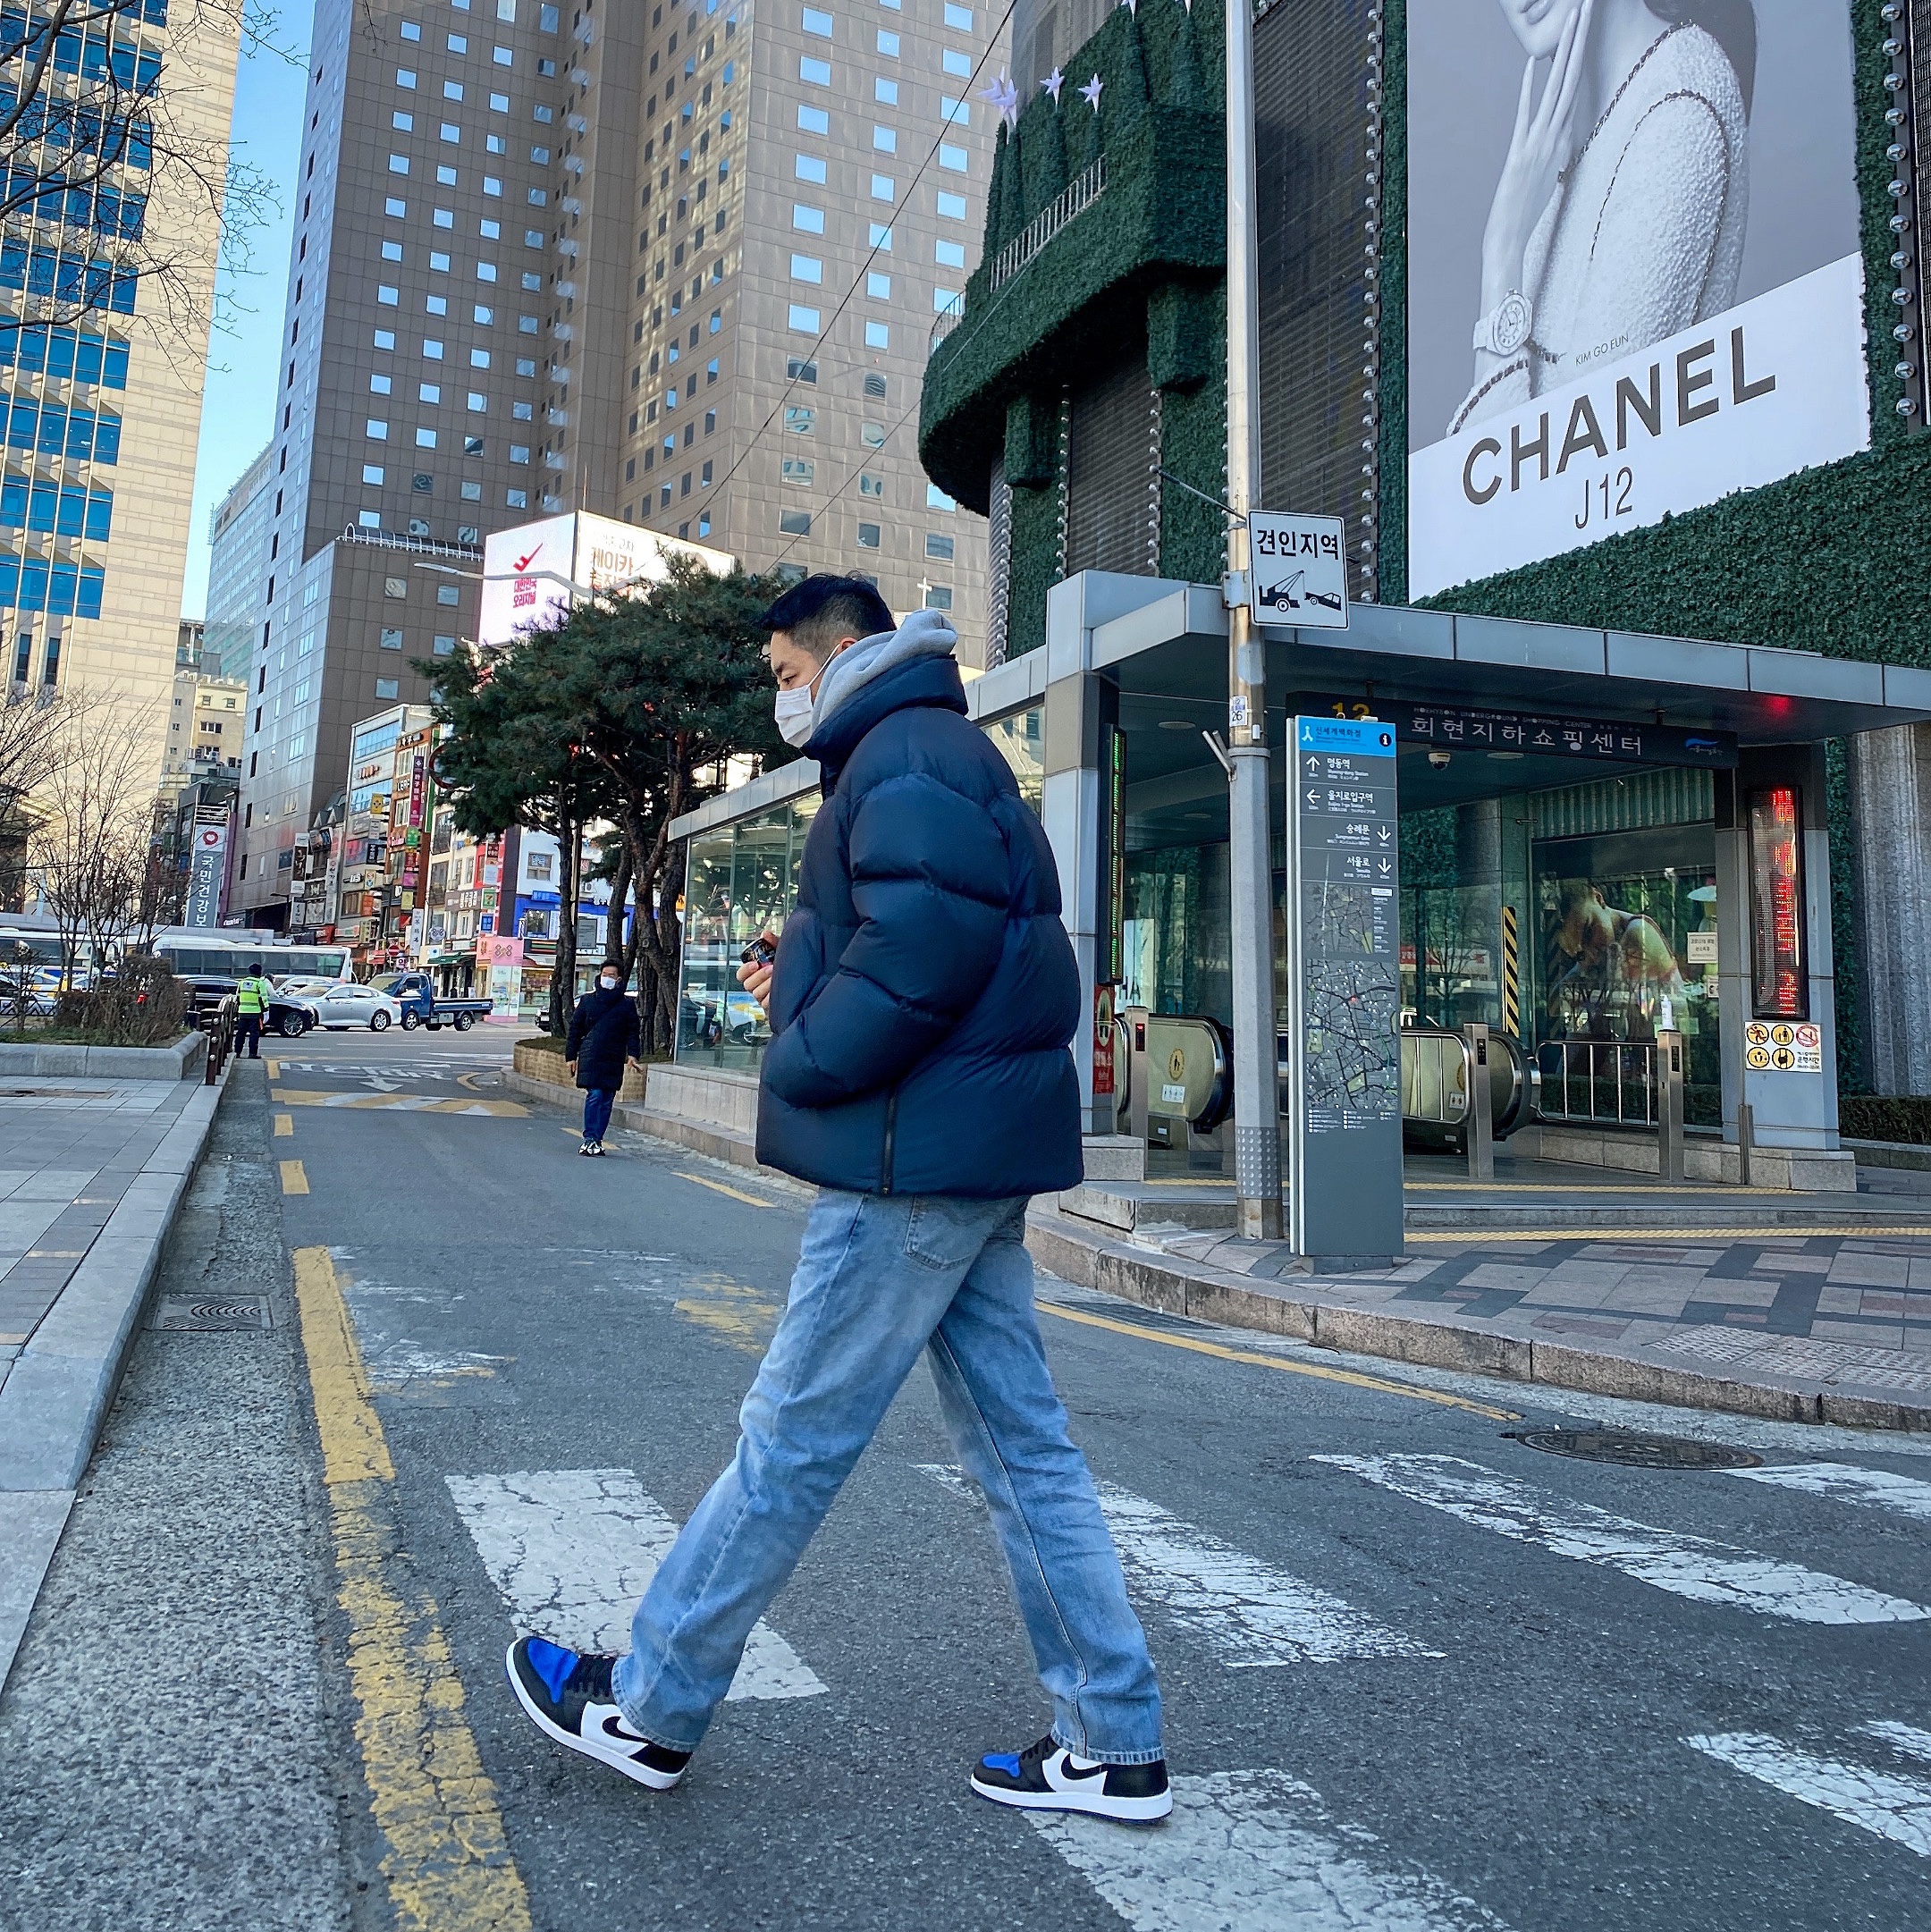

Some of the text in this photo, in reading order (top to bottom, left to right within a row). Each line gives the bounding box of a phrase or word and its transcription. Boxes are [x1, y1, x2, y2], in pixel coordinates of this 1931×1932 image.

[1575, 332, 1629, 367] KIM GO EUN
[1463, 325, 1775, 505] CHANEL
[1574, 466, 1633, 529] J12
[1256, 529, 1339, 561] 견인지역
[514, 578, 537, 593] 대한민국
[513, 591, 536, 608] 오리지널
[1232, 710, 1243, 721] 26
[1315, 727, 1362, 738] 신세계백화점
[1412, 717, 1641, 756] 회현지하쇼핑센터
[1327, 757, 1351, 770] 명동역
[1328, 789, 1374, 804] 을지로입구역
[1345, 823, 1370, 836] 숭례문
[1346, 856, 1371, 867] 서울로
